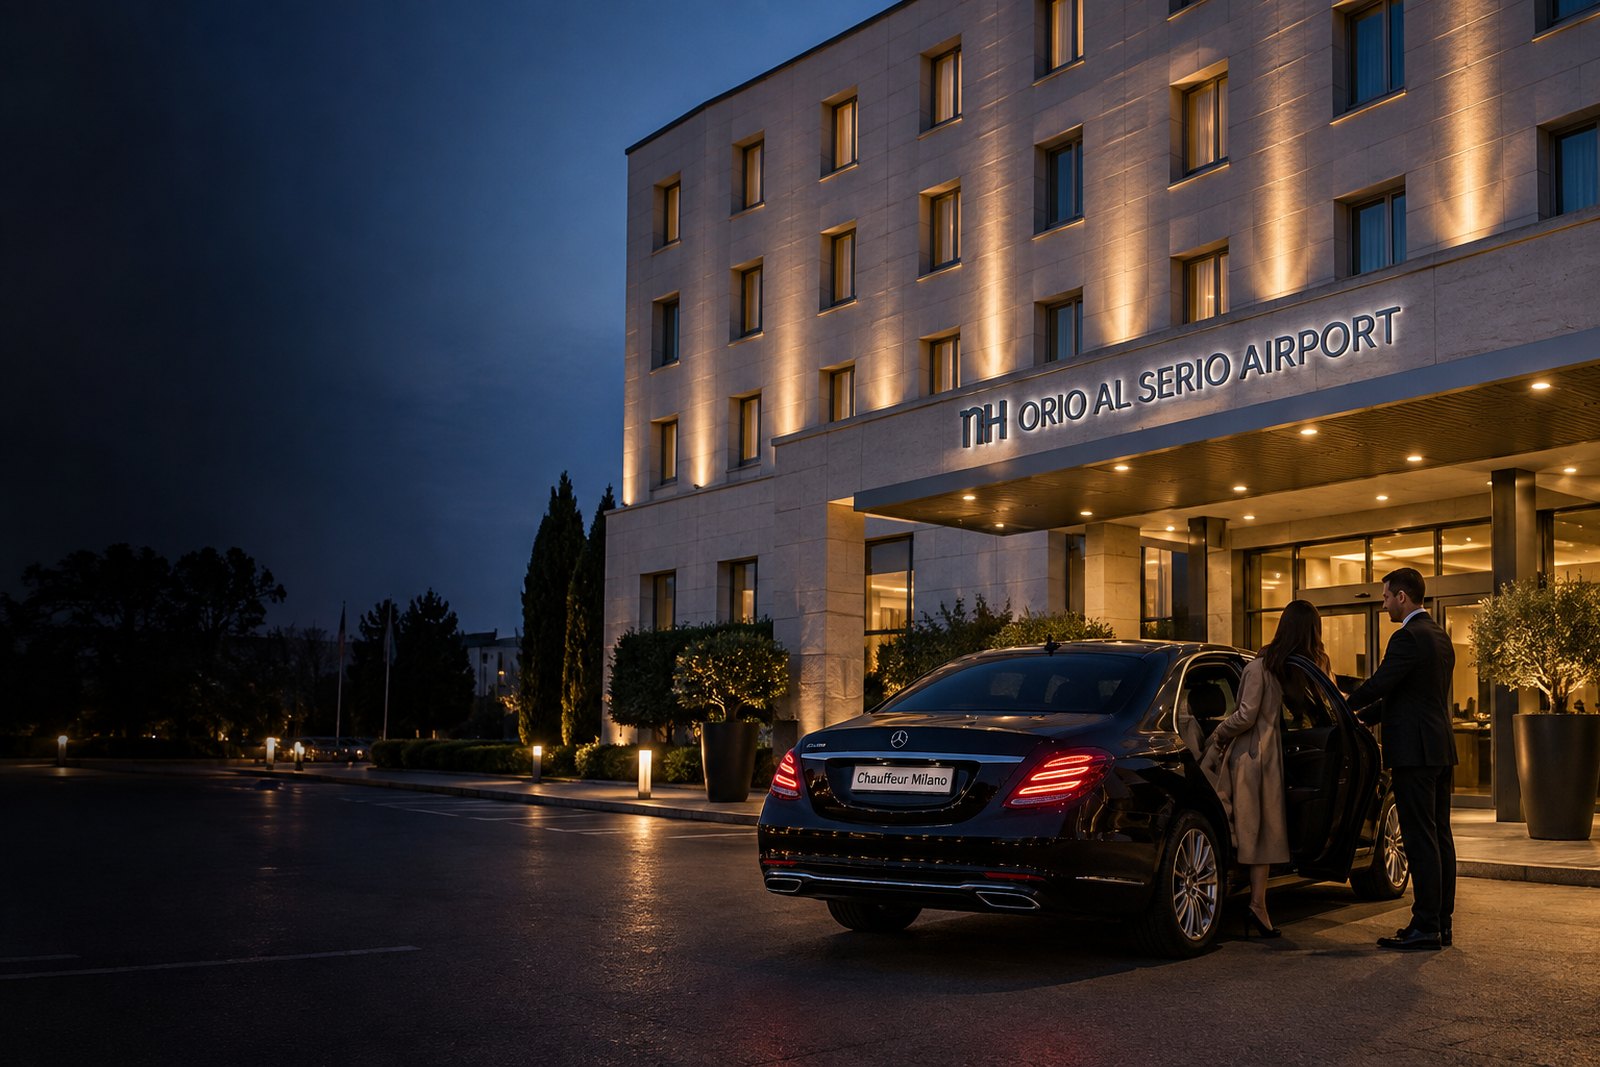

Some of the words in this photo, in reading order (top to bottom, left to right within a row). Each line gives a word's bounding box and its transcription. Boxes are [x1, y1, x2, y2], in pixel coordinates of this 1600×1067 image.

[1018, 389, 1087, 431] ORIO
[1093, 380, 1131, 415] AL
[1138, 353, 1231, 403] SERIO
[1240, 306, 1401, 380] AIRPORT
[857, 772, 909, 785] Chauffeur
[911, 773, 947, 786] Milano
